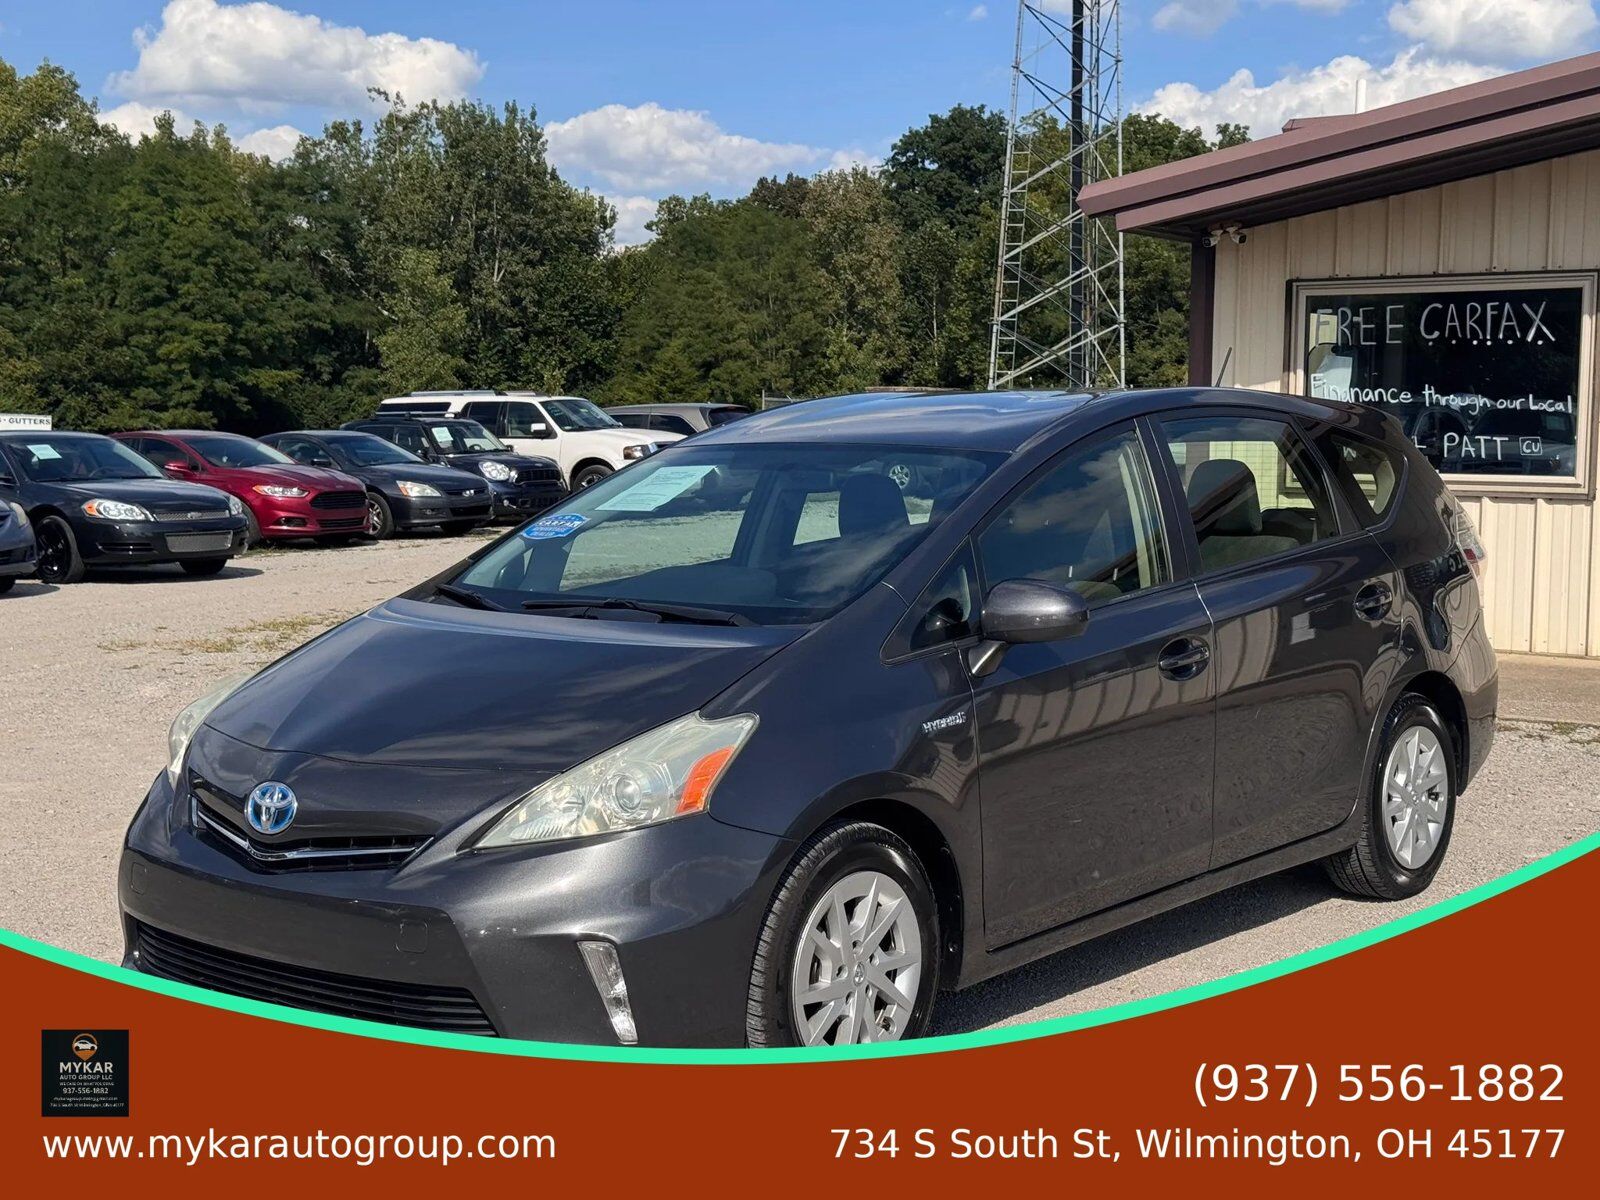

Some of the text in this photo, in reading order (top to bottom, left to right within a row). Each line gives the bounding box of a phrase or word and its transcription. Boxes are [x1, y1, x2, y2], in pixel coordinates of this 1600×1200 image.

[1315, 301, 1556, 346] FREE CARFAX
[1422, 384, 1491, 416] through
[1496, 396, 1527, 411] our
[9, 417, 51, 425] GUTTERS
[1444, 432, 1509, 461] PATT
[1522, 440, 1540, 454] CU
